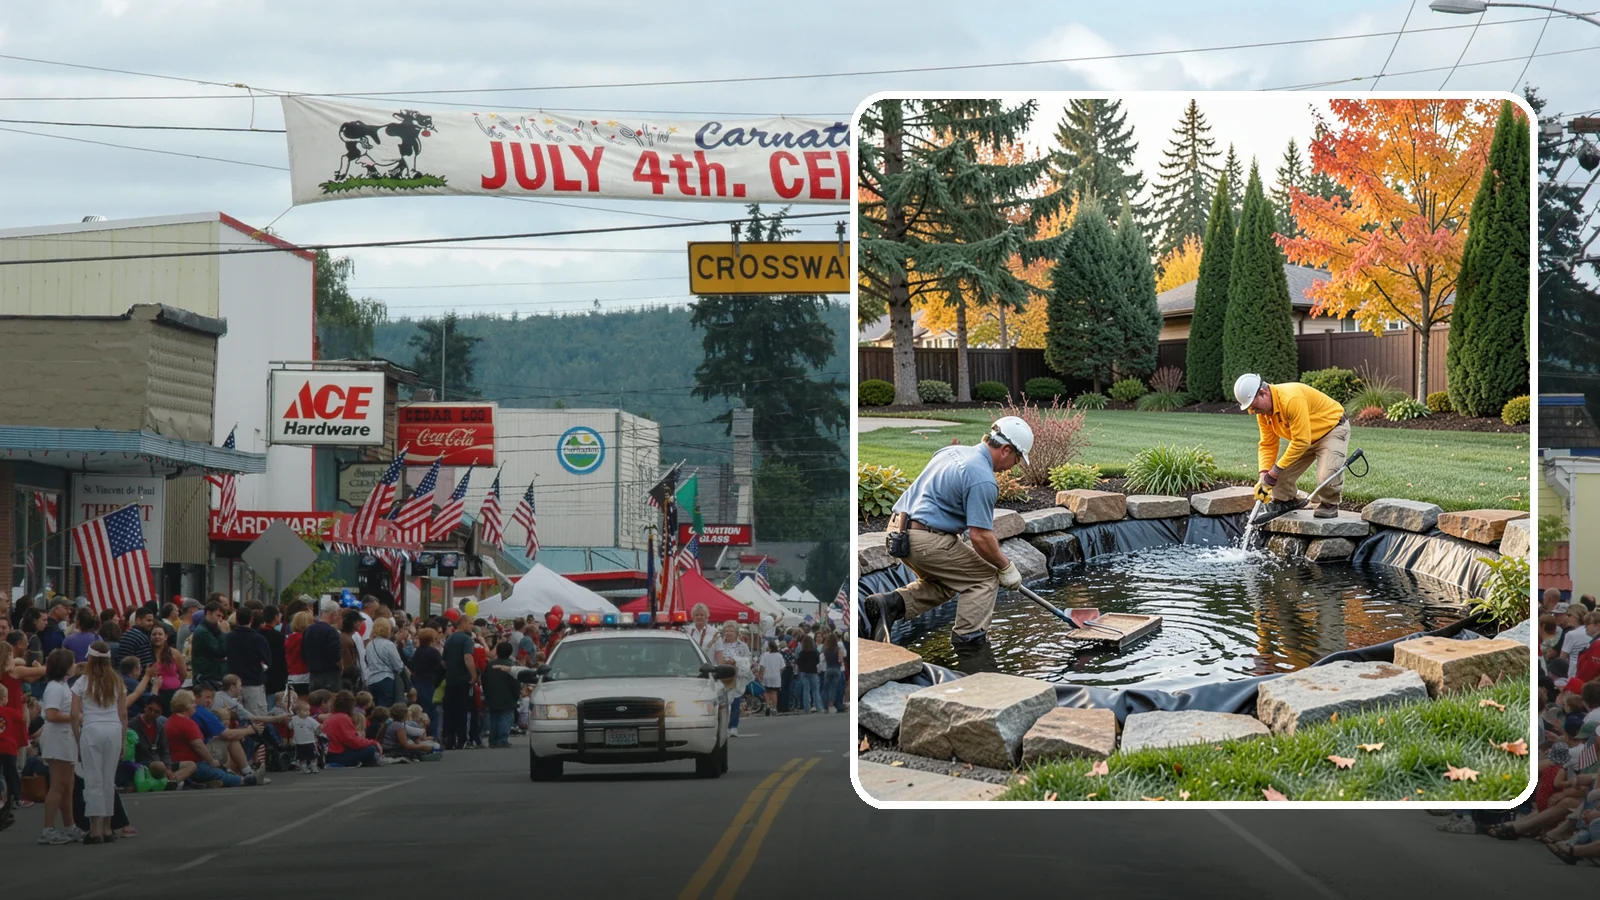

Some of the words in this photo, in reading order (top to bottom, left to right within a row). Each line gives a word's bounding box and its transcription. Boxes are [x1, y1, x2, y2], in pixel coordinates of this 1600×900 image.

[481, 141, 604, 192] JULY
[632, 150, 746, 197] 4th.
[697, 254, 850, 280] CROSSWA
[282, 380, 373, 419] ACE
[405, 409, 452, 422] CEDAR
[283, 421, 371, 436] Hardware
[96, 485, 124, 495] Vincent
[126, 486, 136, 495] de
[137, 486, 155, 495] Paul
[213, 516, 330, 535] HARDARE
[688, 526, 741, 535] CRNATION
[699, 535, 730, 543] GLASS
